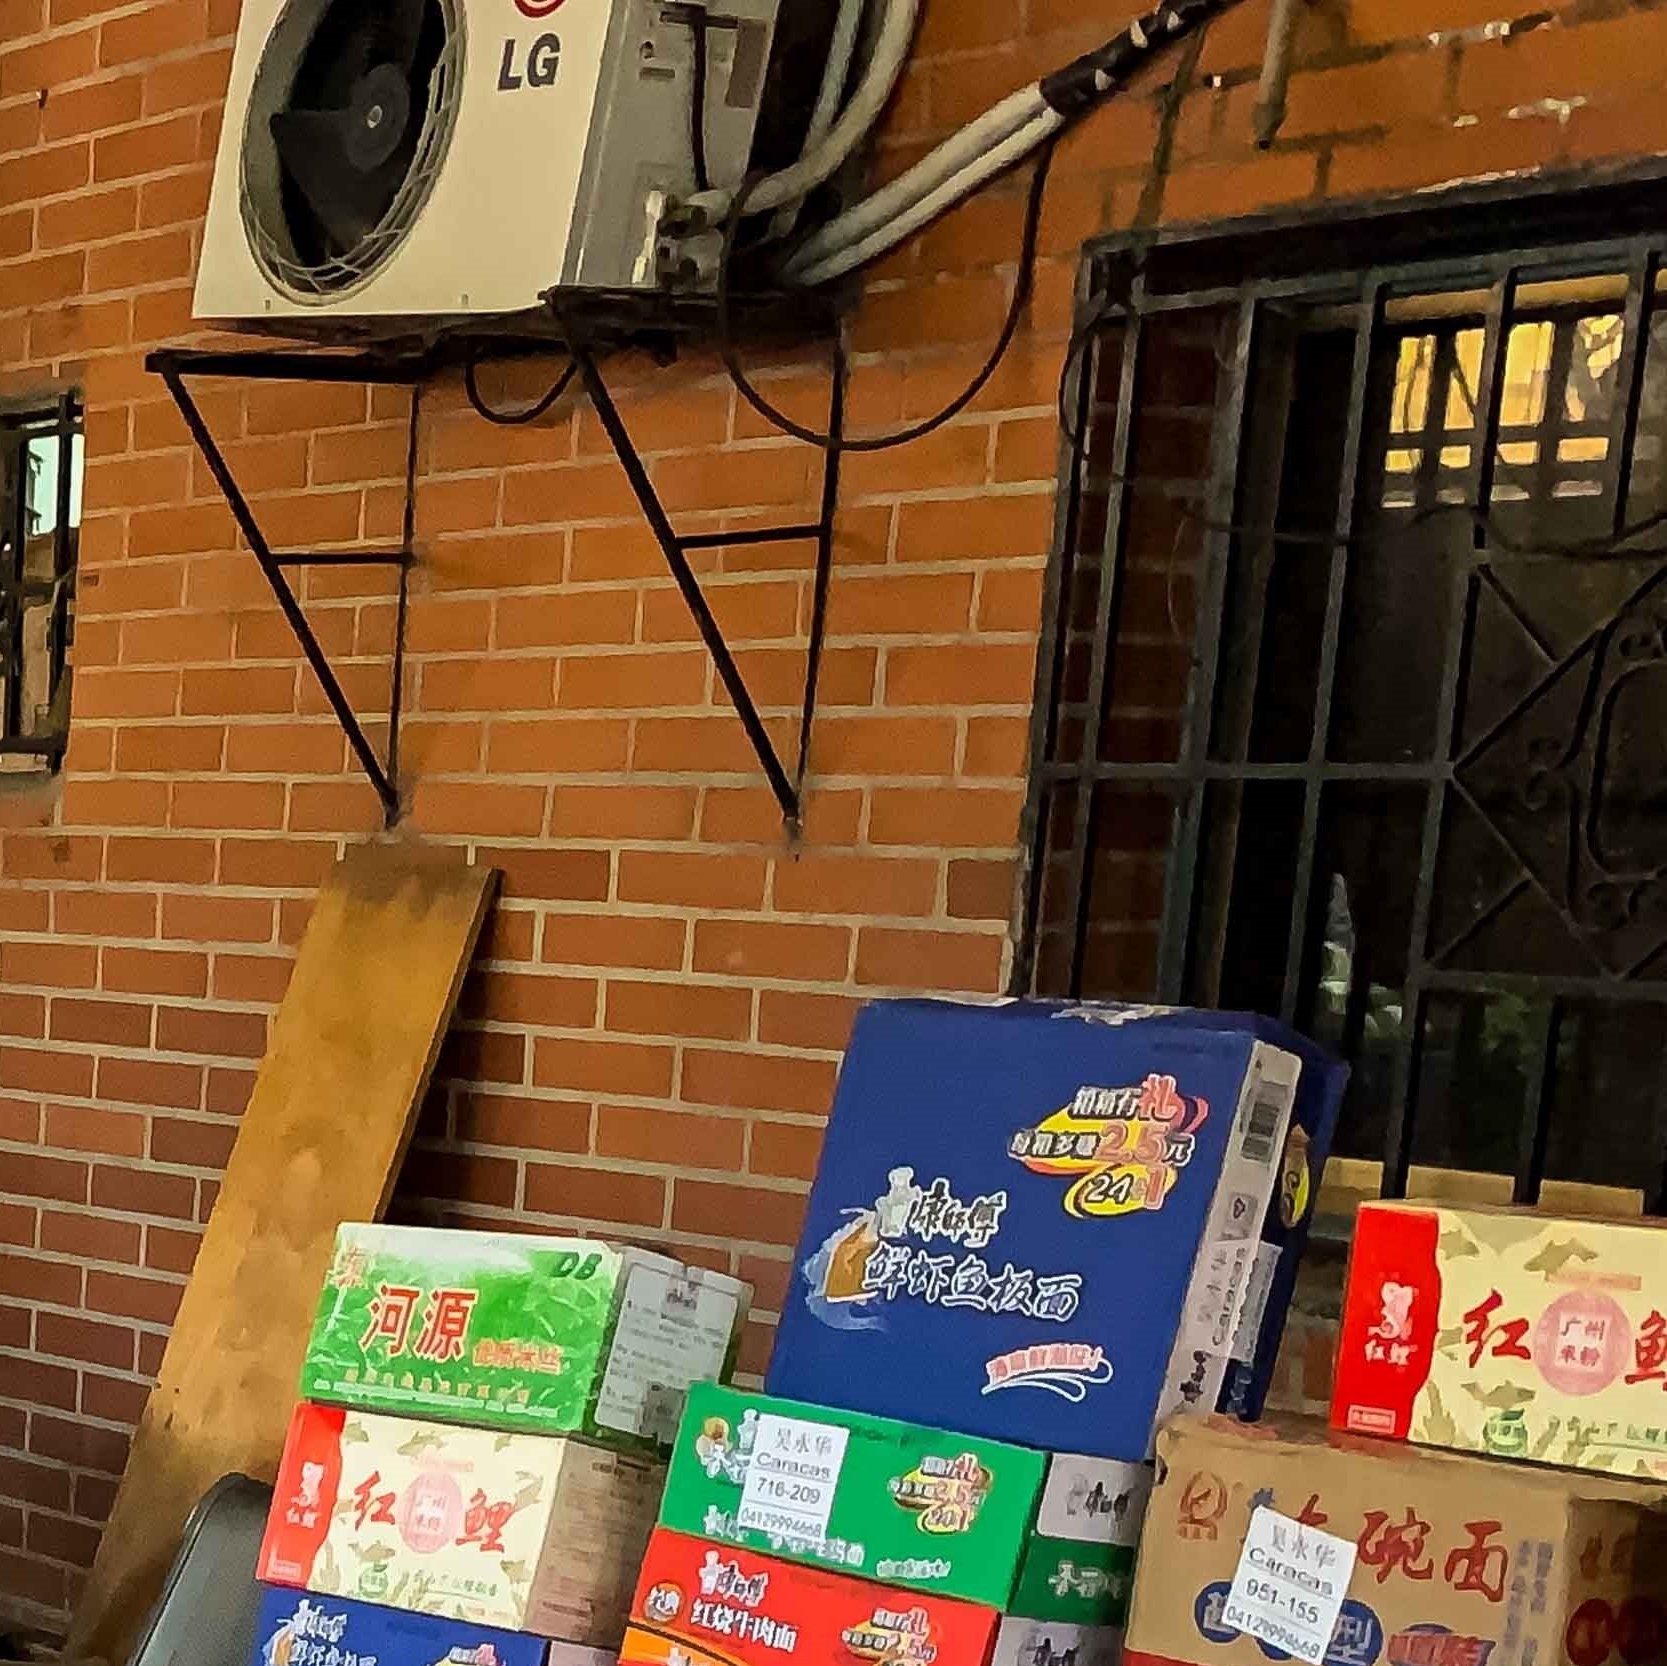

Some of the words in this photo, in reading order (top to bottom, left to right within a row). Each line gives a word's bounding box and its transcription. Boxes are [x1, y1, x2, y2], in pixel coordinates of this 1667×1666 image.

[497, 32, 561, 91] LG
[864, 1244, 1083, 1322] 鲜虾鱼板面
[360, 1282, 479, 1364] 河源
[1462, 1287, 1534, 1369] 红
[756, 1452, 831, 1479] Caracas
[757, 1477, 820, 1505] 716-209
[353, 1469, 397, 1532] 红
[455, 1488, 516, 1554] 鲤
[1247, 1546, 1335, 1597] Caracas
[689, 1602, 798, 1654] 红烧牛肉面
[1243, 1578, 1322, 1627] 951-155
